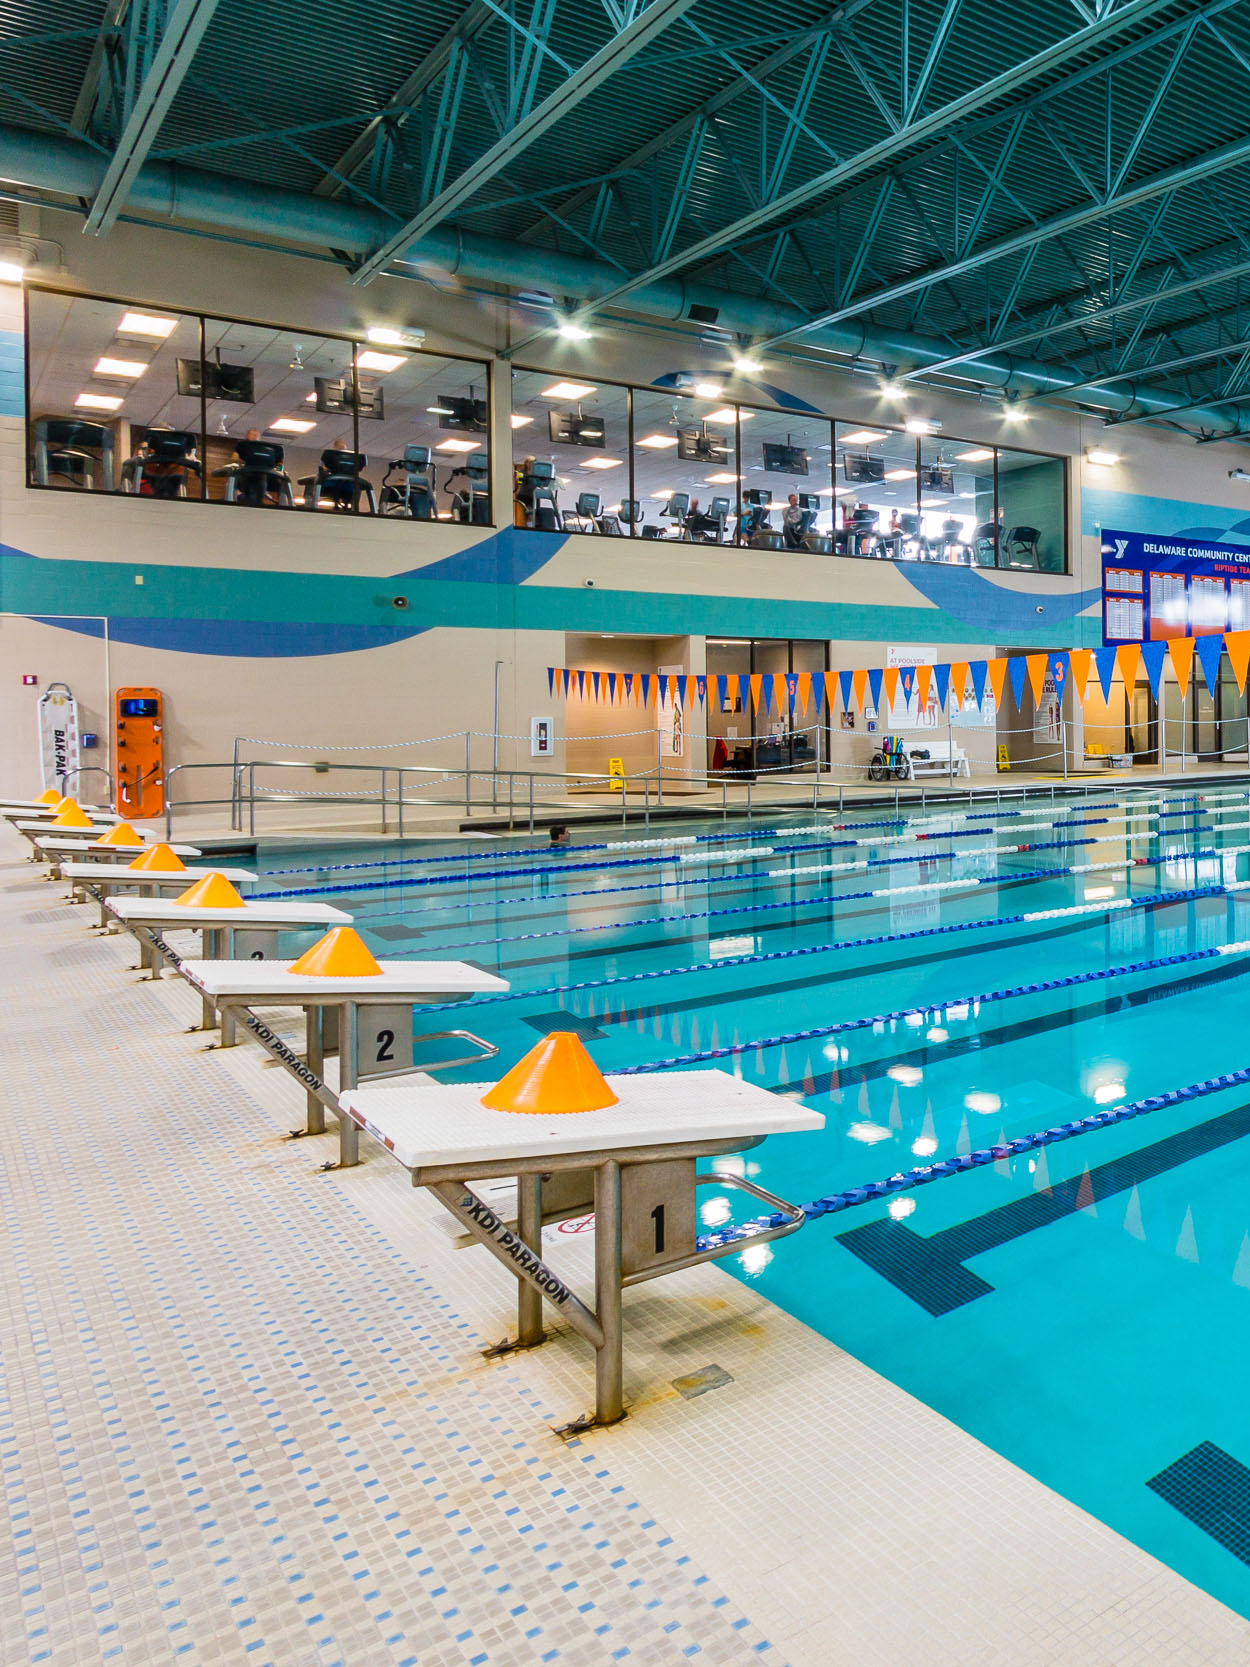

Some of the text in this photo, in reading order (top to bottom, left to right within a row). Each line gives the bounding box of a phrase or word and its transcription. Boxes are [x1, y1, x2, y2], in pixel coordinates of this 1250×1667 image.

[1143, 543, 1186, 556] DELAWARE
[1187, 547, 1234, 561] COMMUNITY
[1214, 564, 1238, 574] RIPTIDE
[1055, 661, 1063, 682] 3
[789, 680, 795, 695] 5
[152, 937, 171, 954] KDI
[251, 1021, 322, 1091] KDI PARAGON
[376, 1029, 395, 1062] 2
[651, 1204, 665, 1254] 1
[467, 1201, 571, 1305] KDI PARAGON
